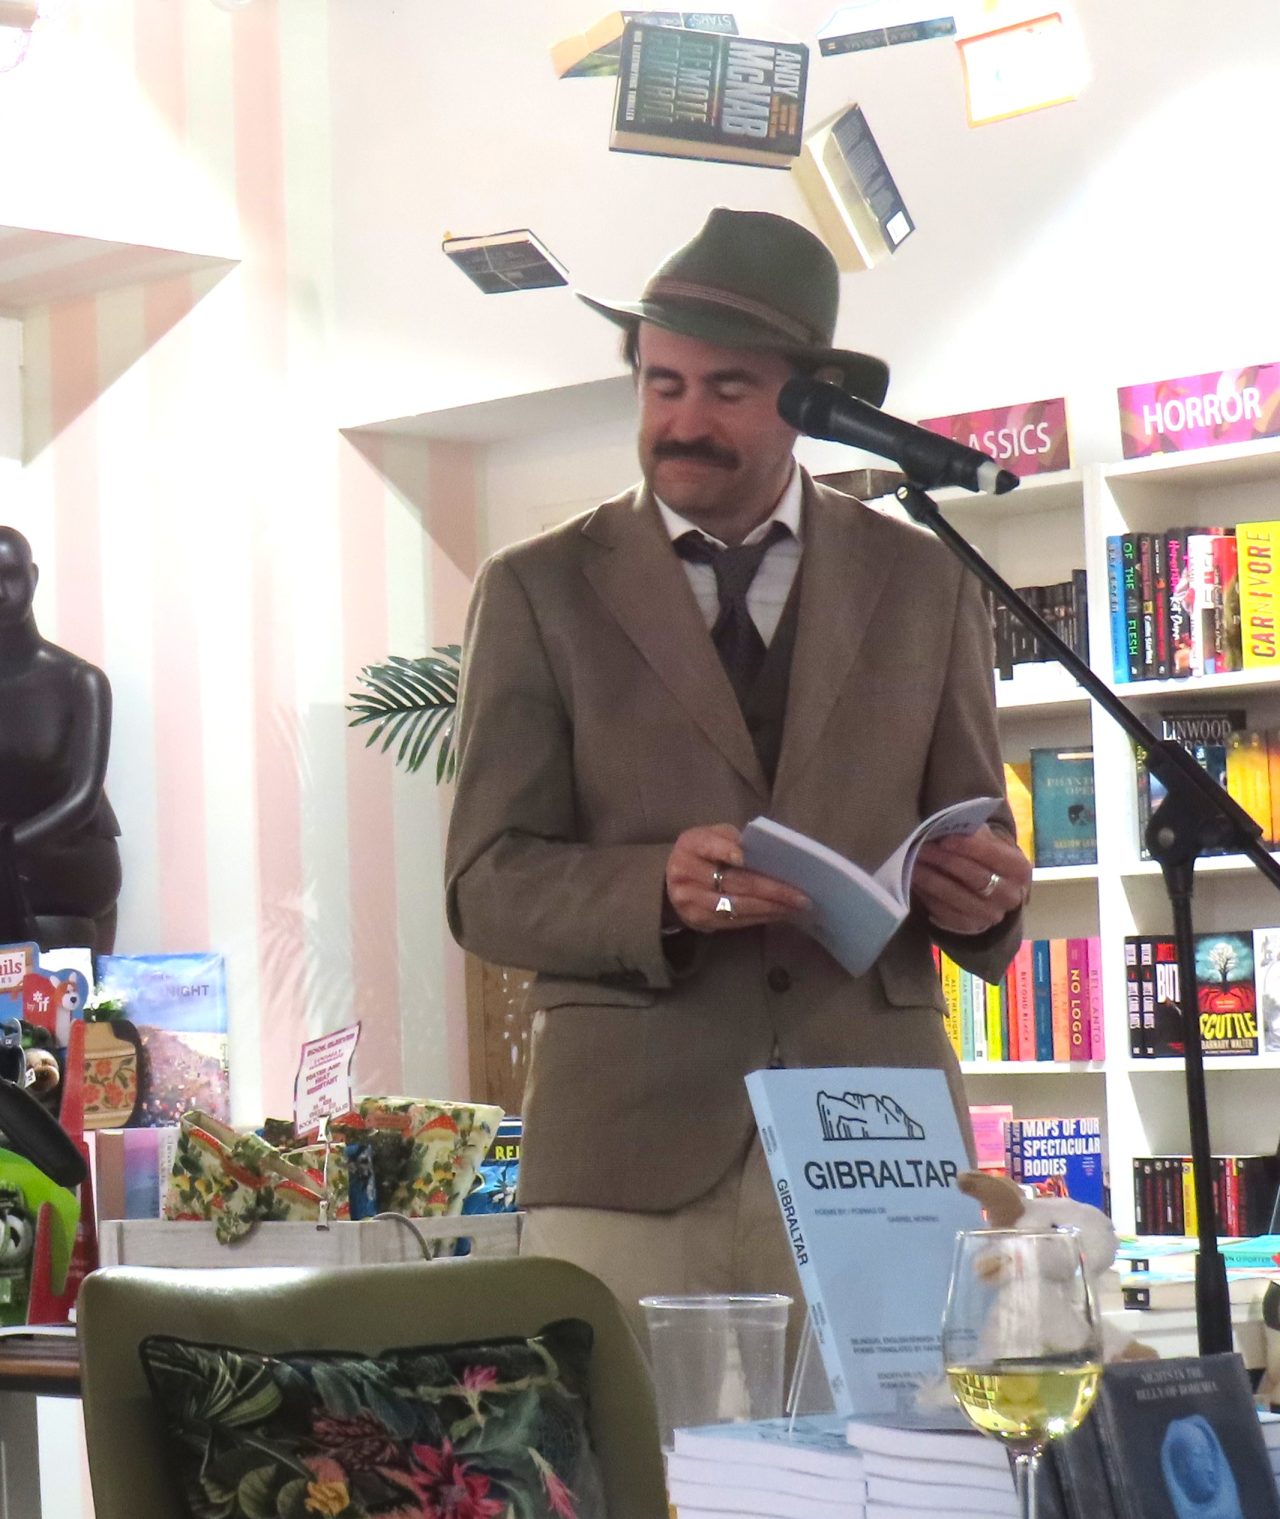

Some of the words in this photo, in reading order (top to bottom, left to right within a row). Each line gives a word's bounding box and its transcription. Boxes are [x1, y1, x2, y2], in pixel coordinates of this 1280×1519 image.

[641, 33, 682, 124] CONTROL
[676, 42, 715, 125] REMOTE
[773, 49, 802, 98] ANDY
[721, 42, 775, 138] McNAB
[625, 90, 637, 121] THRILLER
[1143, 387, 1262, 435] HORROR
[962, 422, 1052, 459] ASSICS
[1123, 542, 1133, 559] OF
[1125, 567, 1135, 590] THE
[1247, 530, 1277, 659] CARNIVORE
[1128, 619, 1138, 655] FLESH
[1162, 720, 1231, 741] LINWOOD
[1046, 777, 1094, 787] PHANT
[167, 985, 209, 998] NIGHT
[1070, 969, 1081, 994] NO
[27, 1003, 36, 1012] by
[1092, 994, 1101, 1043] CANTO
[1071, 1000, 1082, 1045] LOGO
[1200, 1012, 1258, 1040] SCUTTLE
[307, 1044, 326, 1057] BOOK
[1230, 1038, 1253, 1049] WALTER
[1023, 1120, 1059, 1137] MAPS
[1062, 1119, 1077, 1136] OF
[1079, 1119, 1100, 1135] OUR
[1023, 1137, 1101, 1158] SPECTACULAR
[804, 1159, 957, 1190] GIBRALTAR
[1023, 1158, 1068, 1177] BODIES
[777, 1178, 808, 1266] GIBRALTAR
[1136, 1387, 1162, 1401] BELLY
[1178, 1381, 1218, 1397] BOHEMIA
